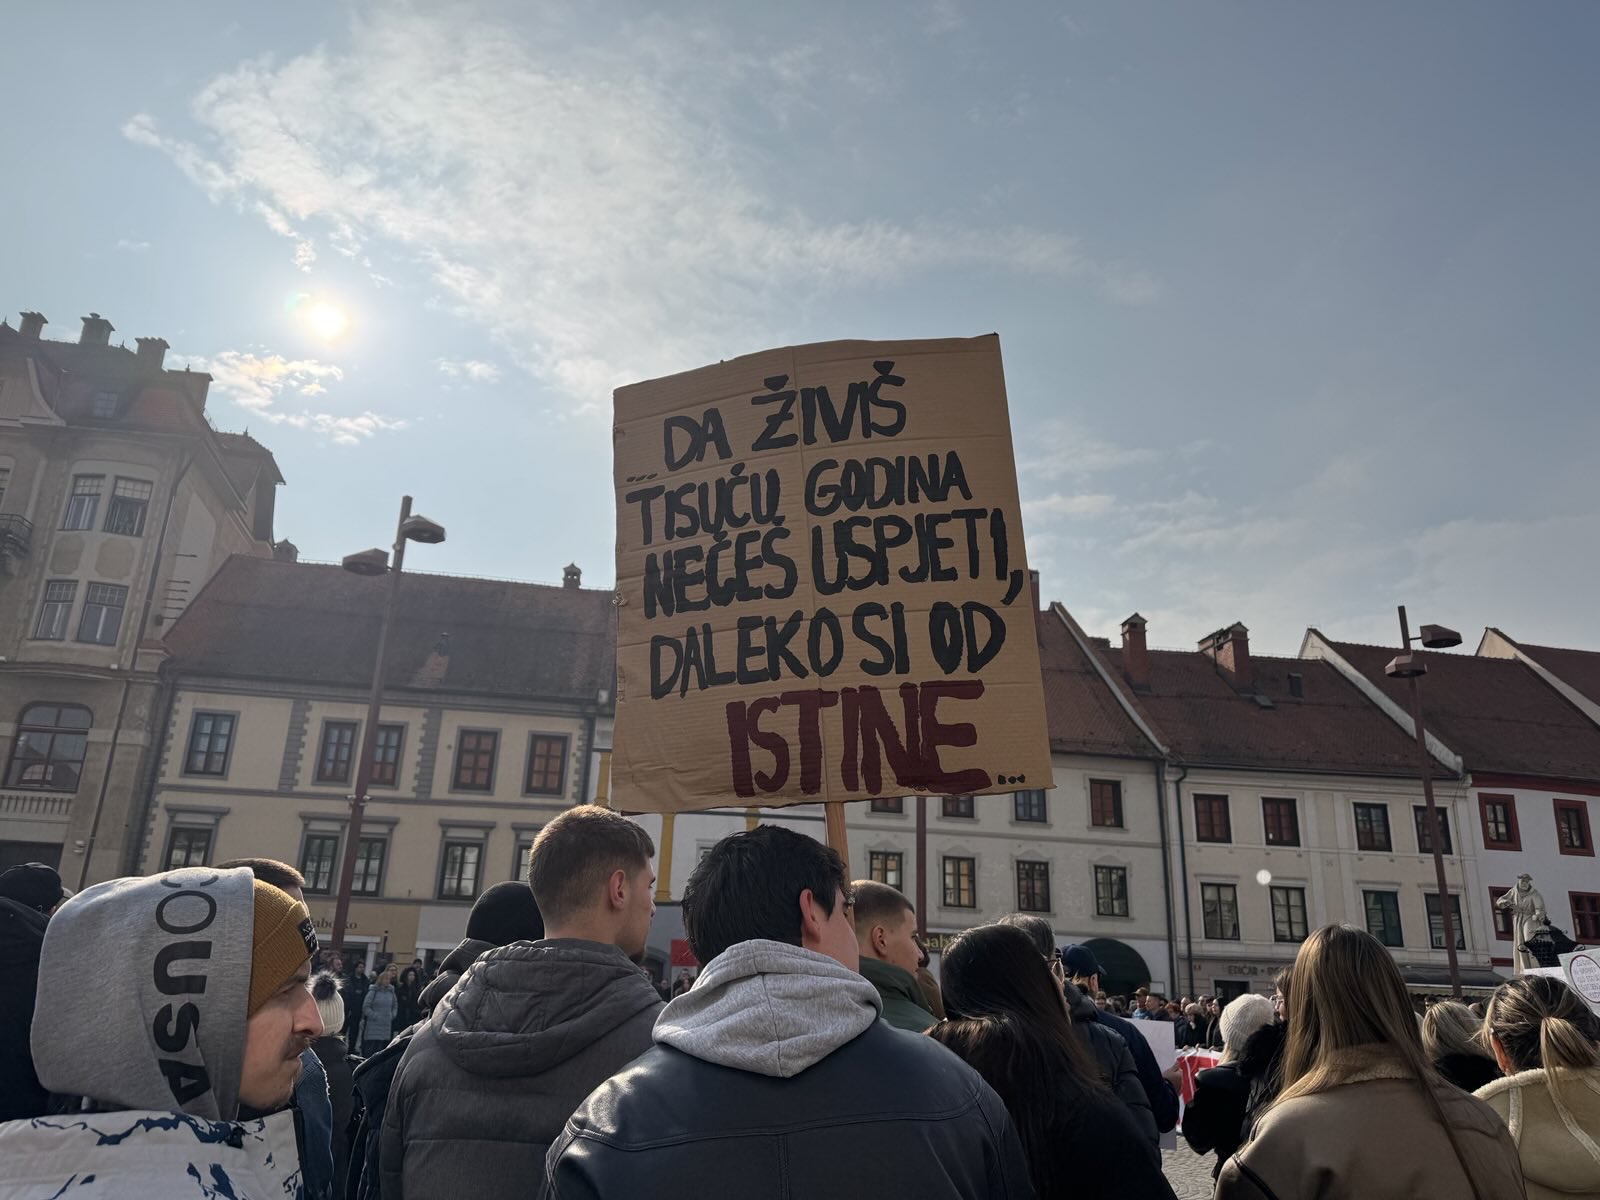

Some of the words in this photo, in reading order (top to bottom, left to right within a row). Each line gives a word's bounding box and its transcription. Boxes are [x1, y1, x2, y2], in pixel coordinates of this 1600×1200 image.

[751, 360, 907, 452] ŽIVIŠ
[625, 462, 781, 546] TISUĆU
[804, 450, 973, 516] GODINA
[643, 515, 799, 620] NEĆEŠ
[811, 508, 1024, 606] USPJETI,
[650, 607, 843, 700] DALEKO
[851, 601, 910, 676] SI
[929, 601, 1007, 675] OD
